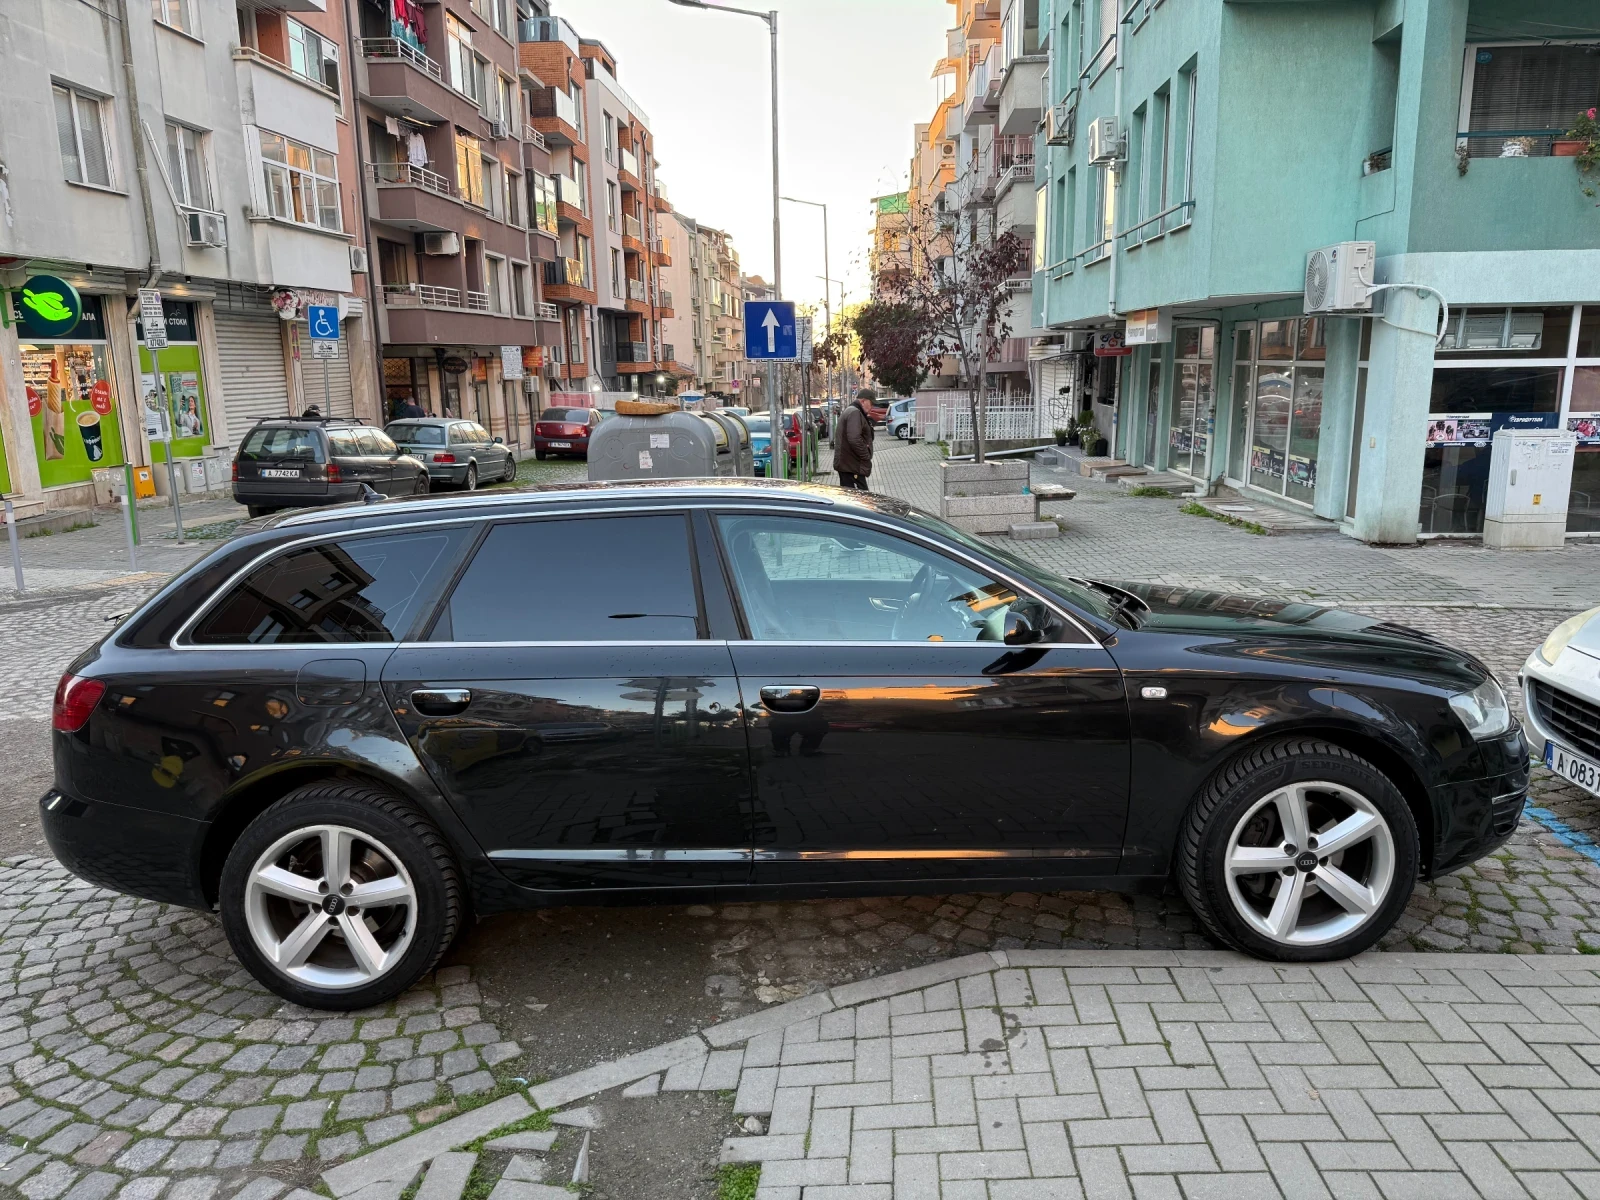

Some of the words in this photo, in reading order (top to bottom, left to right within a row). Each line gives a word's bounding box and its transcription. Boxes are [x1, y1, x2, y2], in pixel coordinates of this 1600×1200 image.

[168, 318, 188, 326] СТОКИ
[1301, 760, 1372, 784] SEMPERIT
[1557, 752, 1564, 773] A
